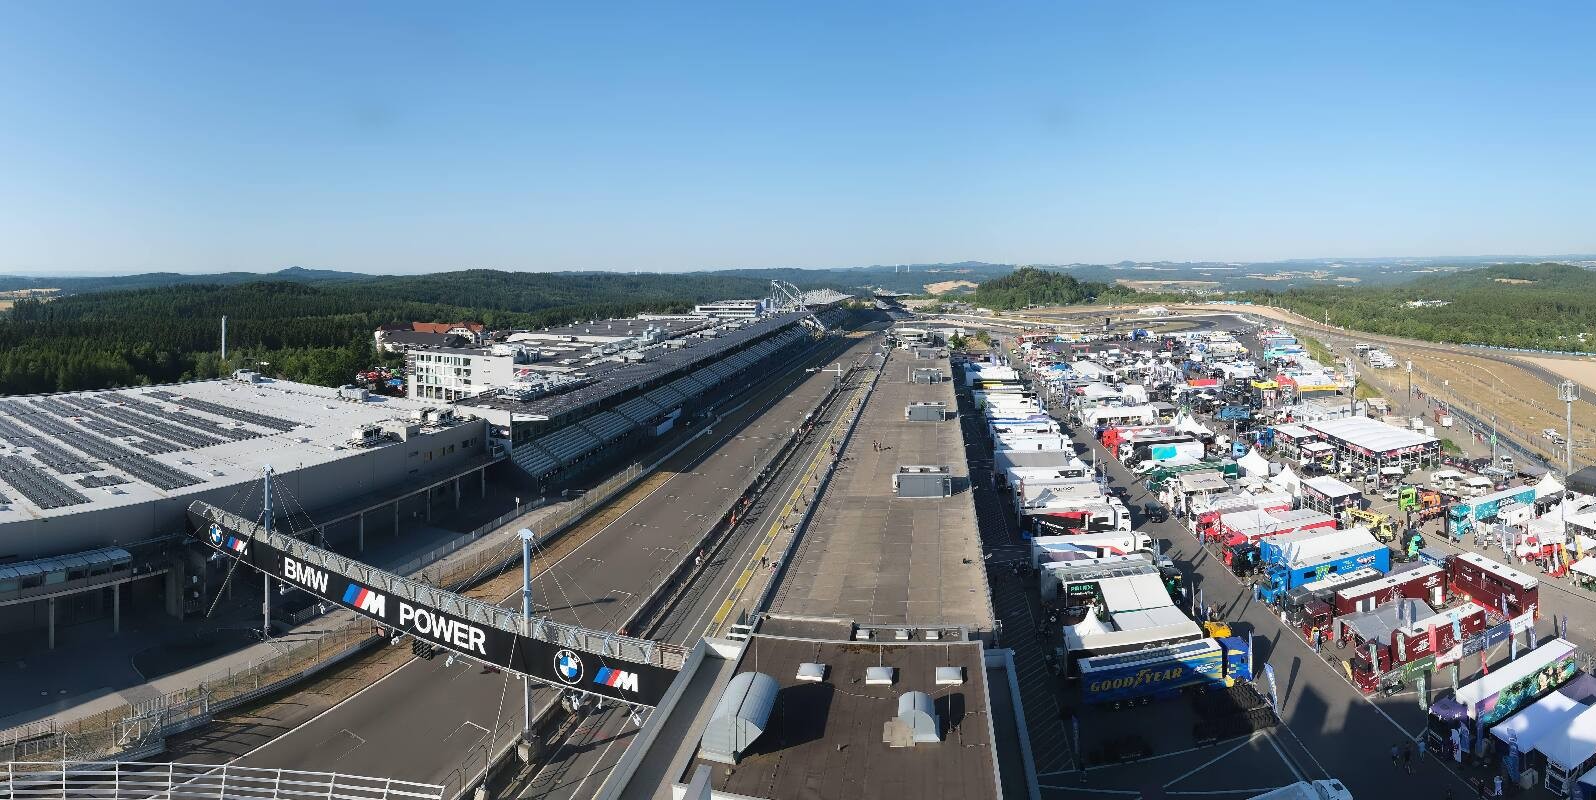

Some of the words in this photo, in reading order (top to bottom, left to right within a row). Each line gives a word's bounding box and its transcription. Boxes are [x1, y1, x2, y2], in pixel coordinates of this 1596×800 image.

[284, 556, 329, 594] BMW
[400, 601, 487, 655] POWER
[1090, 667, 1183, 692] GOODYEAR
